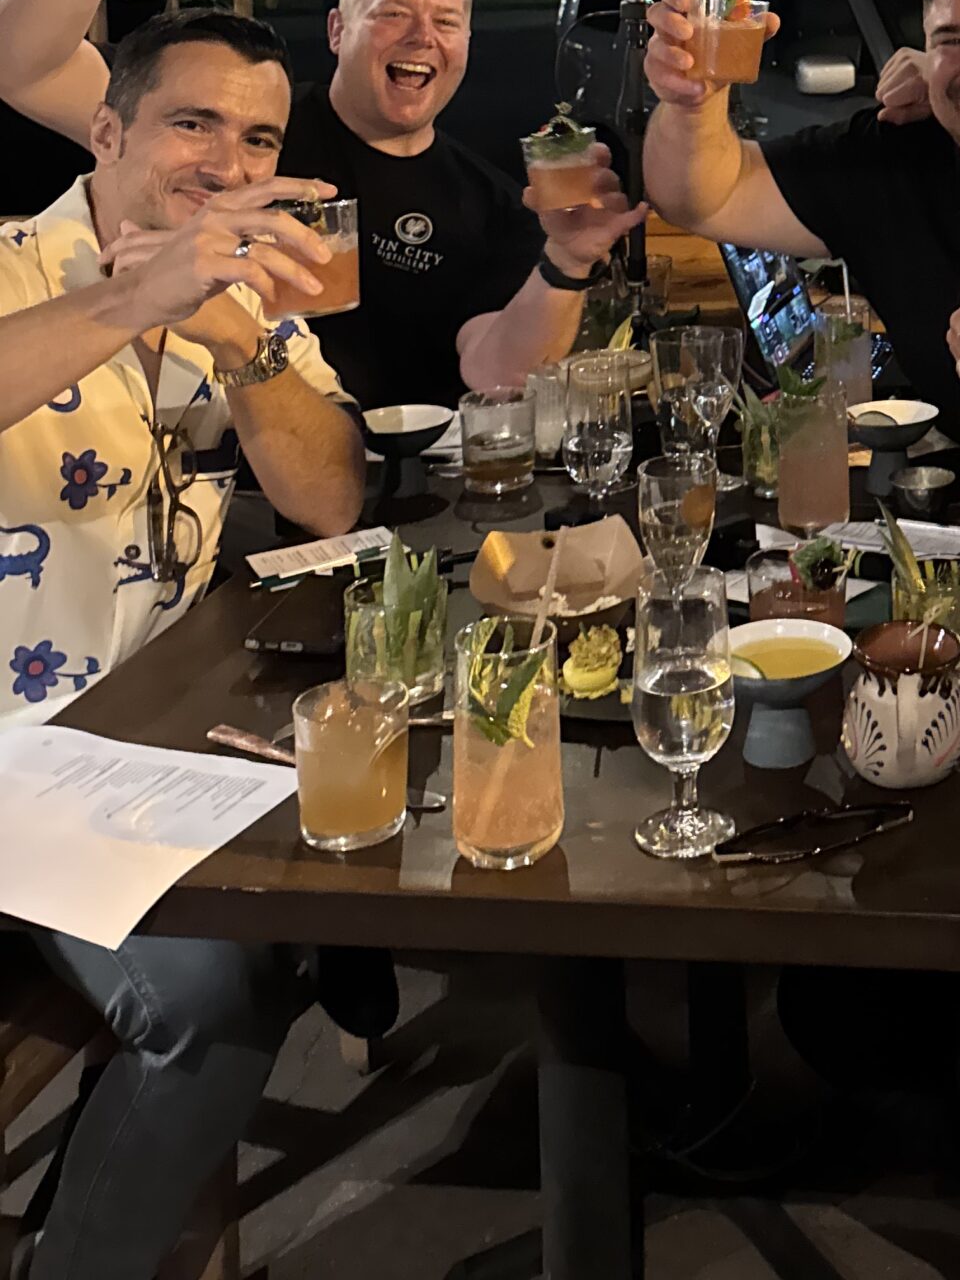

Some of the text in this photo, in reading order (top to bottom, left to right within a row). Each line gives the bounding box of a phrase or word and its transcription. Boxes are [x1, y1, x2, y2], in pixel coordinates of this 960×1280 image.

[371, 233, 444, 266] TIN CITY
[376, 248, 430, 271] DISTILLERY
